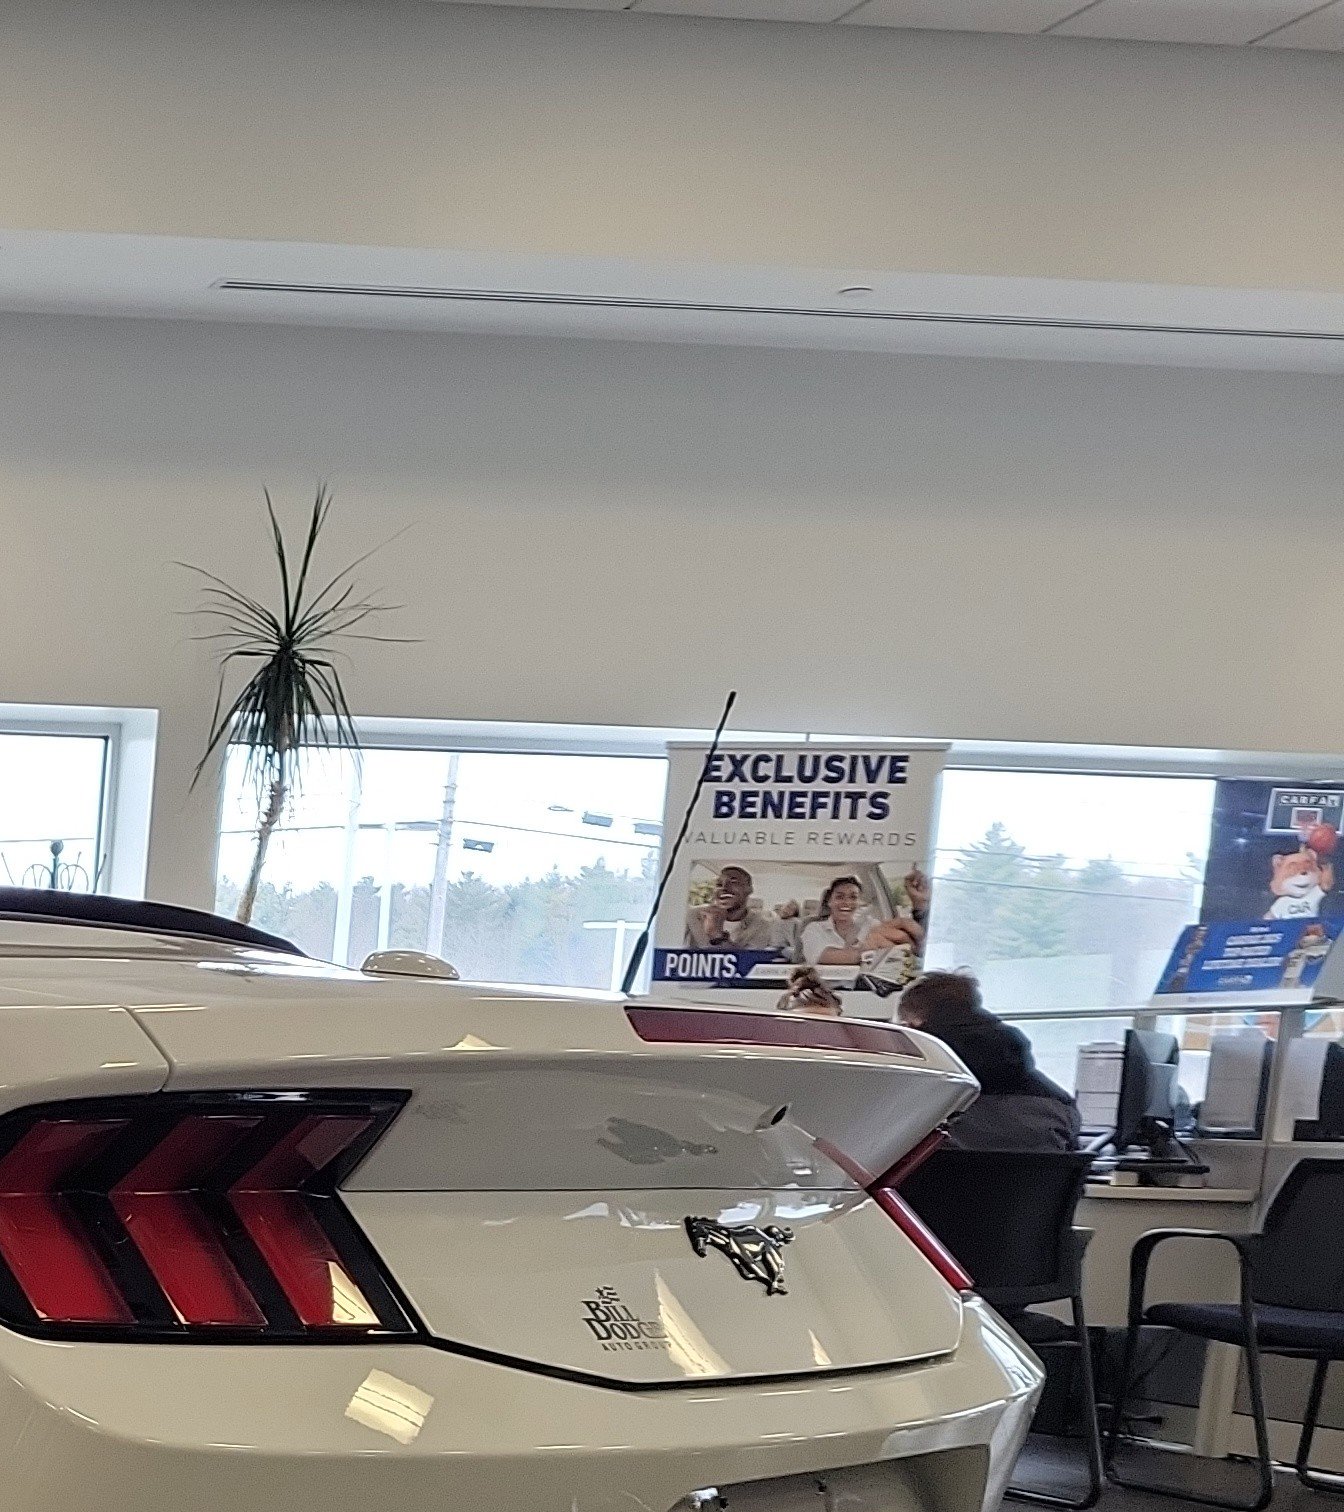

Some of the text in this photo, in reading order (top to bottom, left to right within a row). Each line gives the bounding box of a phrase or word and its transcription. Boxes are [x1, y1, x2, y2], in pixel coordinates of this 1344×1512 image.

[703, 754, 909, 785] EXCLUSIVE
[712, 789, 891, 820] BENEFITS
[684, 831, 917, 847] VALUABLE REWARDS
[665, 953, 742, 979] POINTS.
[582, 1300, 639, 1323] BILL
[582, 1318, 668, 1341] DODGE
[602, 1342, 633, 1351] AUTO
